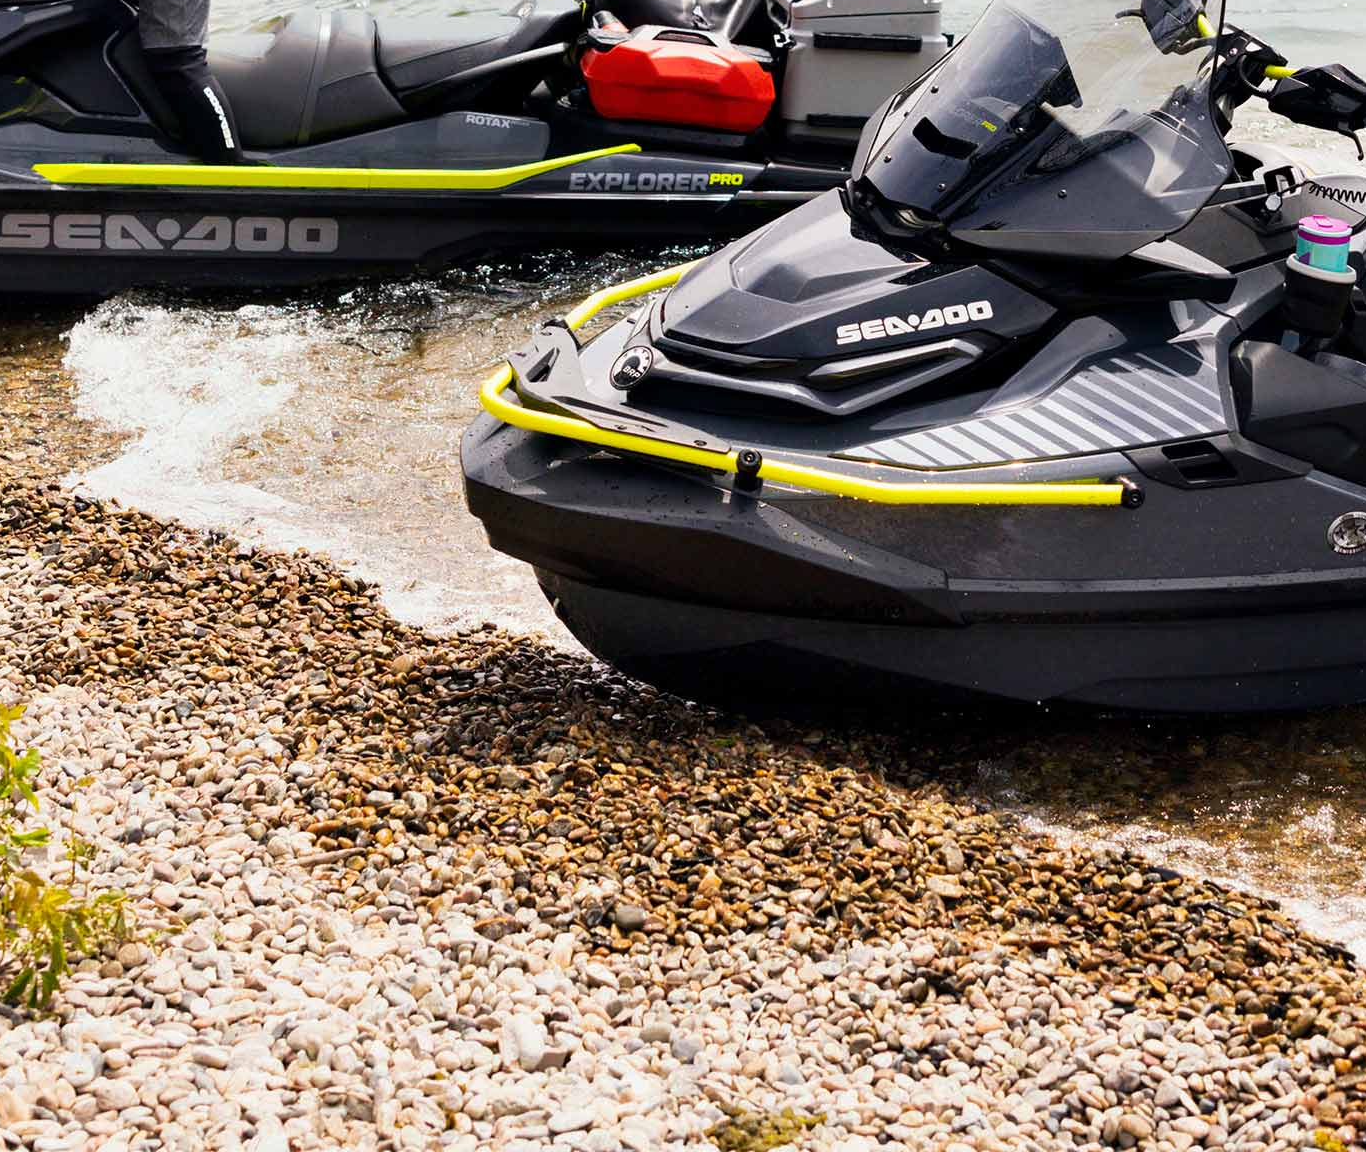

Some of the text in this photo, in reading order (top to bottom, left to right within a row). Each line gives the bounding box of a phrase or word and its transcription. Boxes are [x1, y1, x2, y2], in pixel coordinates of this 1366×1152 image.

[465, 114, 511, 129] ROTAX
[568, 172, 744, 192] EXPLORER PRO
[622, 365, 641, 378] BRP
